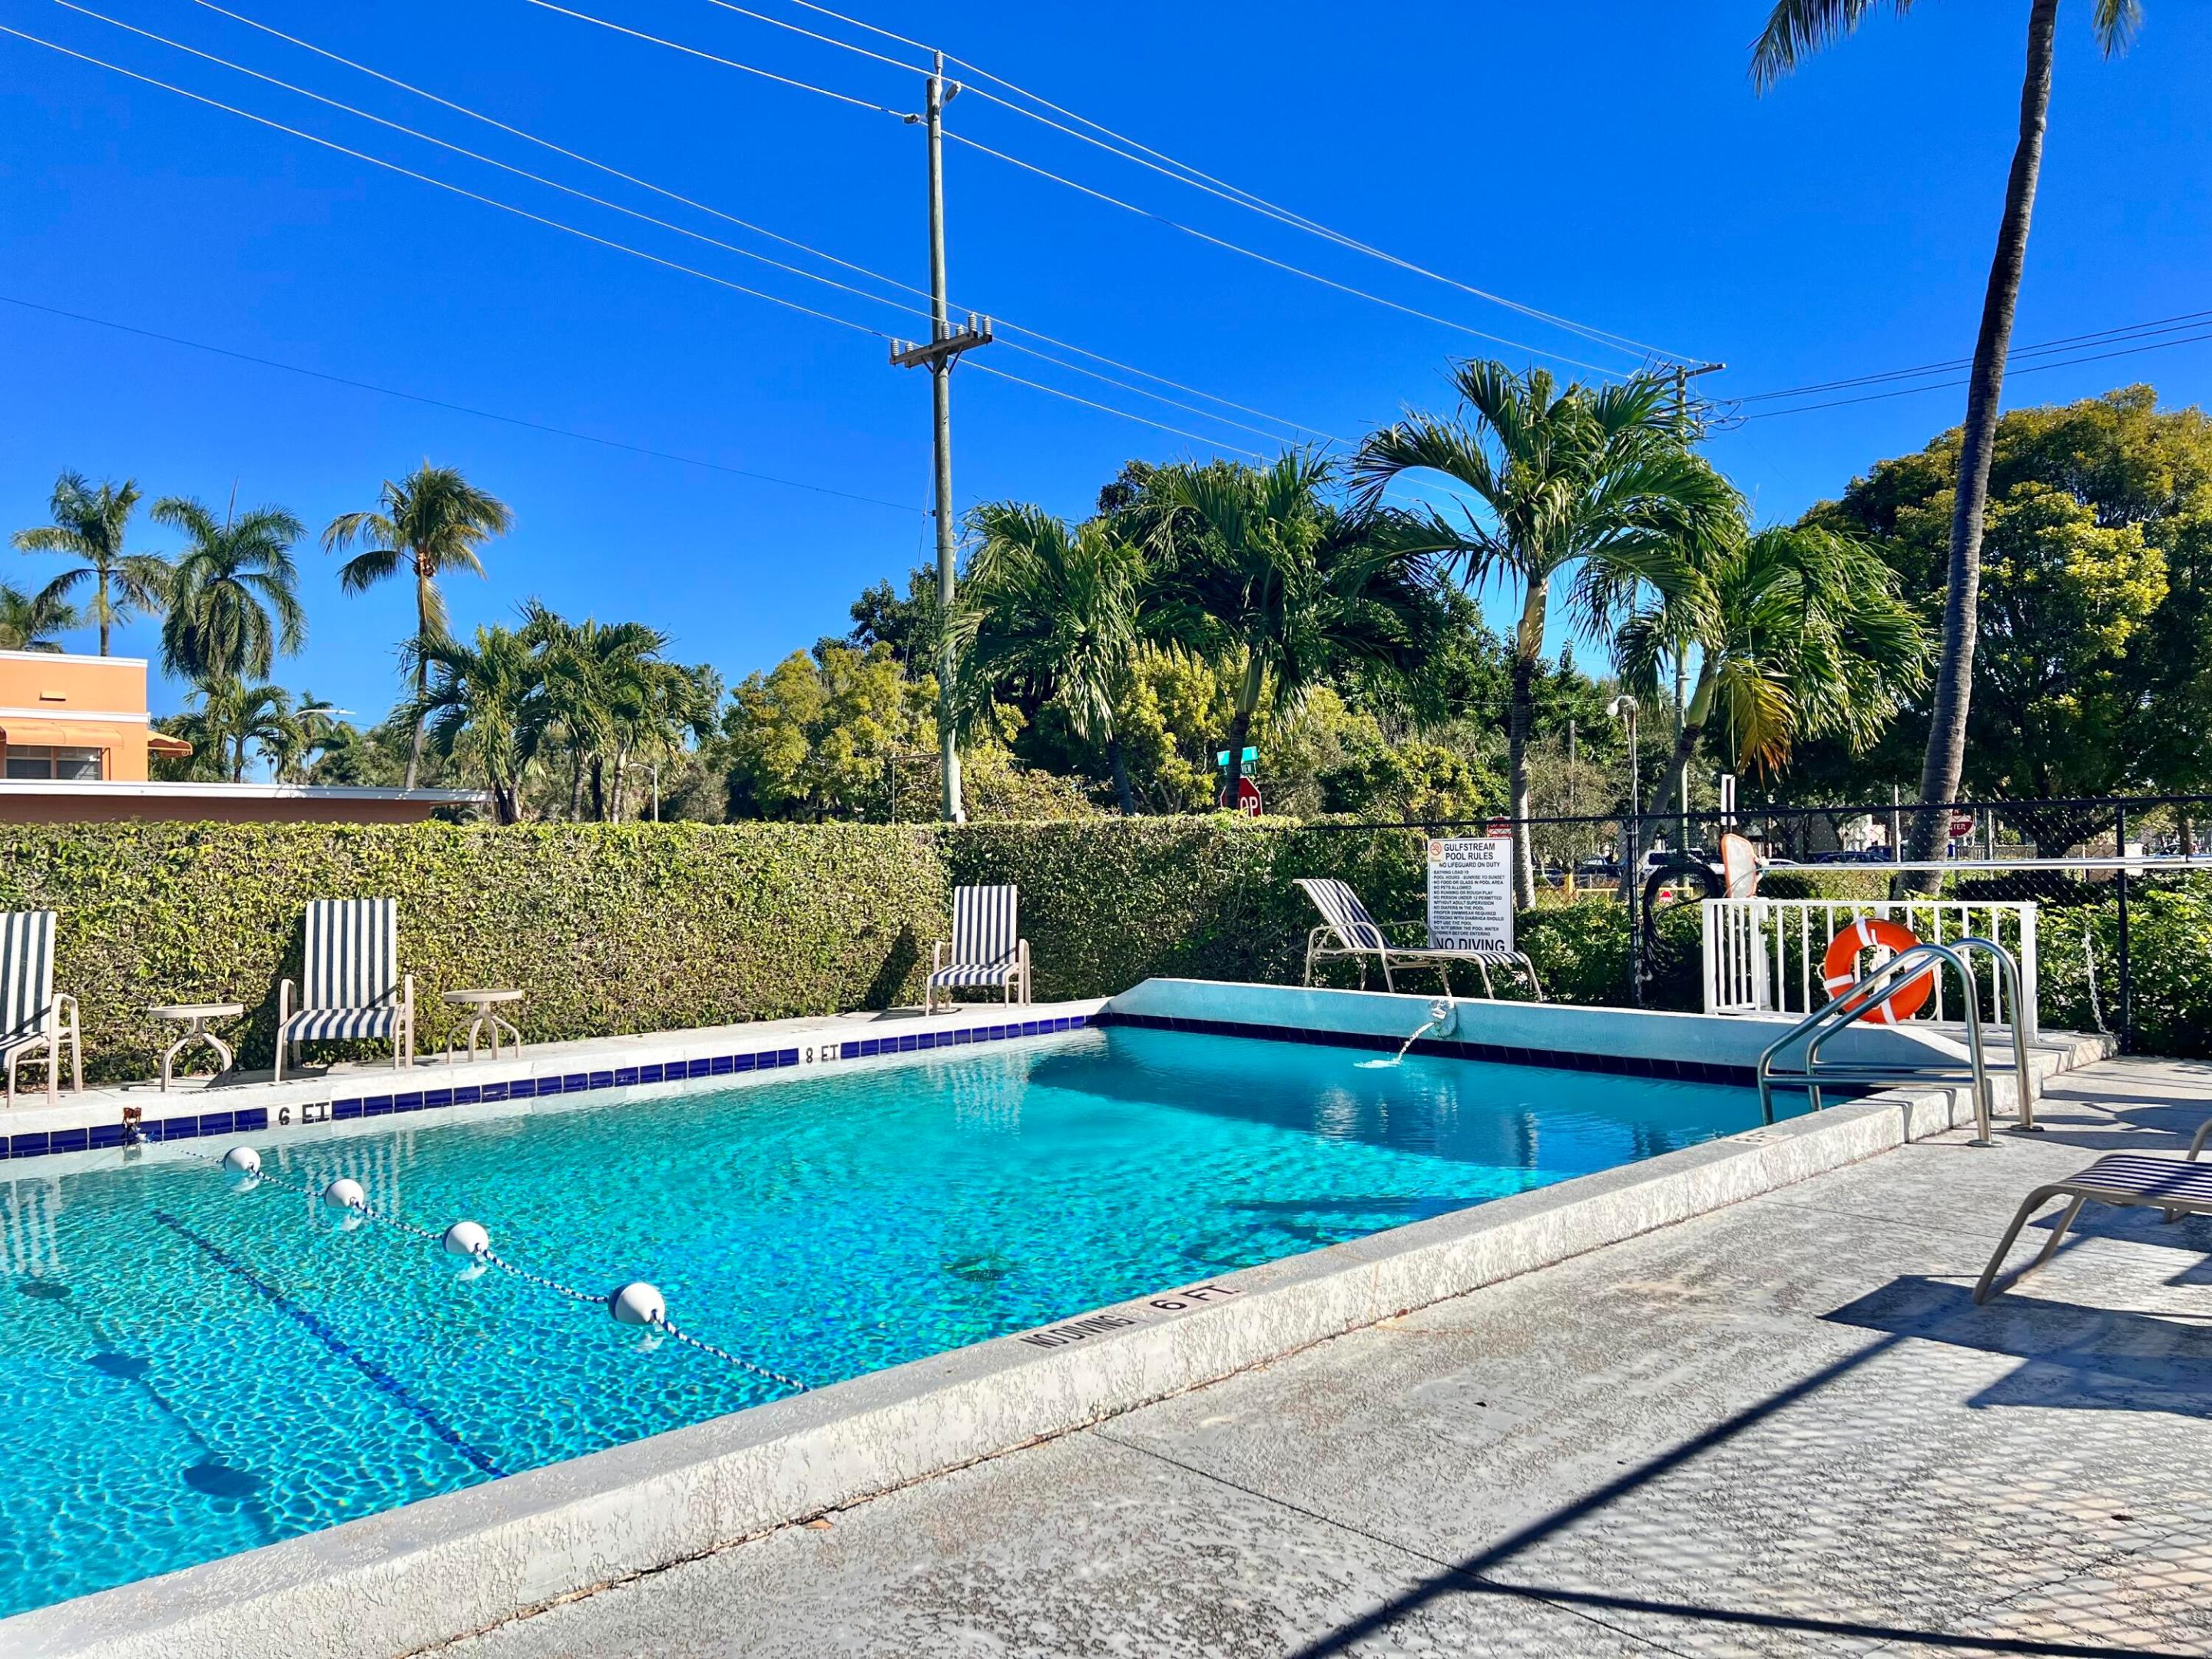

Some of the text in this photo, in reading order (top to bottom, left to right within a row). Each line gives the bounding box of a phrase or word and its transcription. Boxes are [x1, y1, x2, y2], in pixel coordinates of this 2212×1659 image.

[1444, 843, 1495, 852] GULFSTREAM
[1445, 852, 1466, 860] POOL
[1469, 852, 1493, 860] RULES
[1436, 938, 1505, 951] NO DIVING
[806, 1047, 813, 1063] 8
[278, 1107, 290, 1125] 6
[1019, 1333, 1068, 1349] NO
[1048, 1315, 1137, 1340] DIVING
[1149, 1300, 1187, 1310] 6
